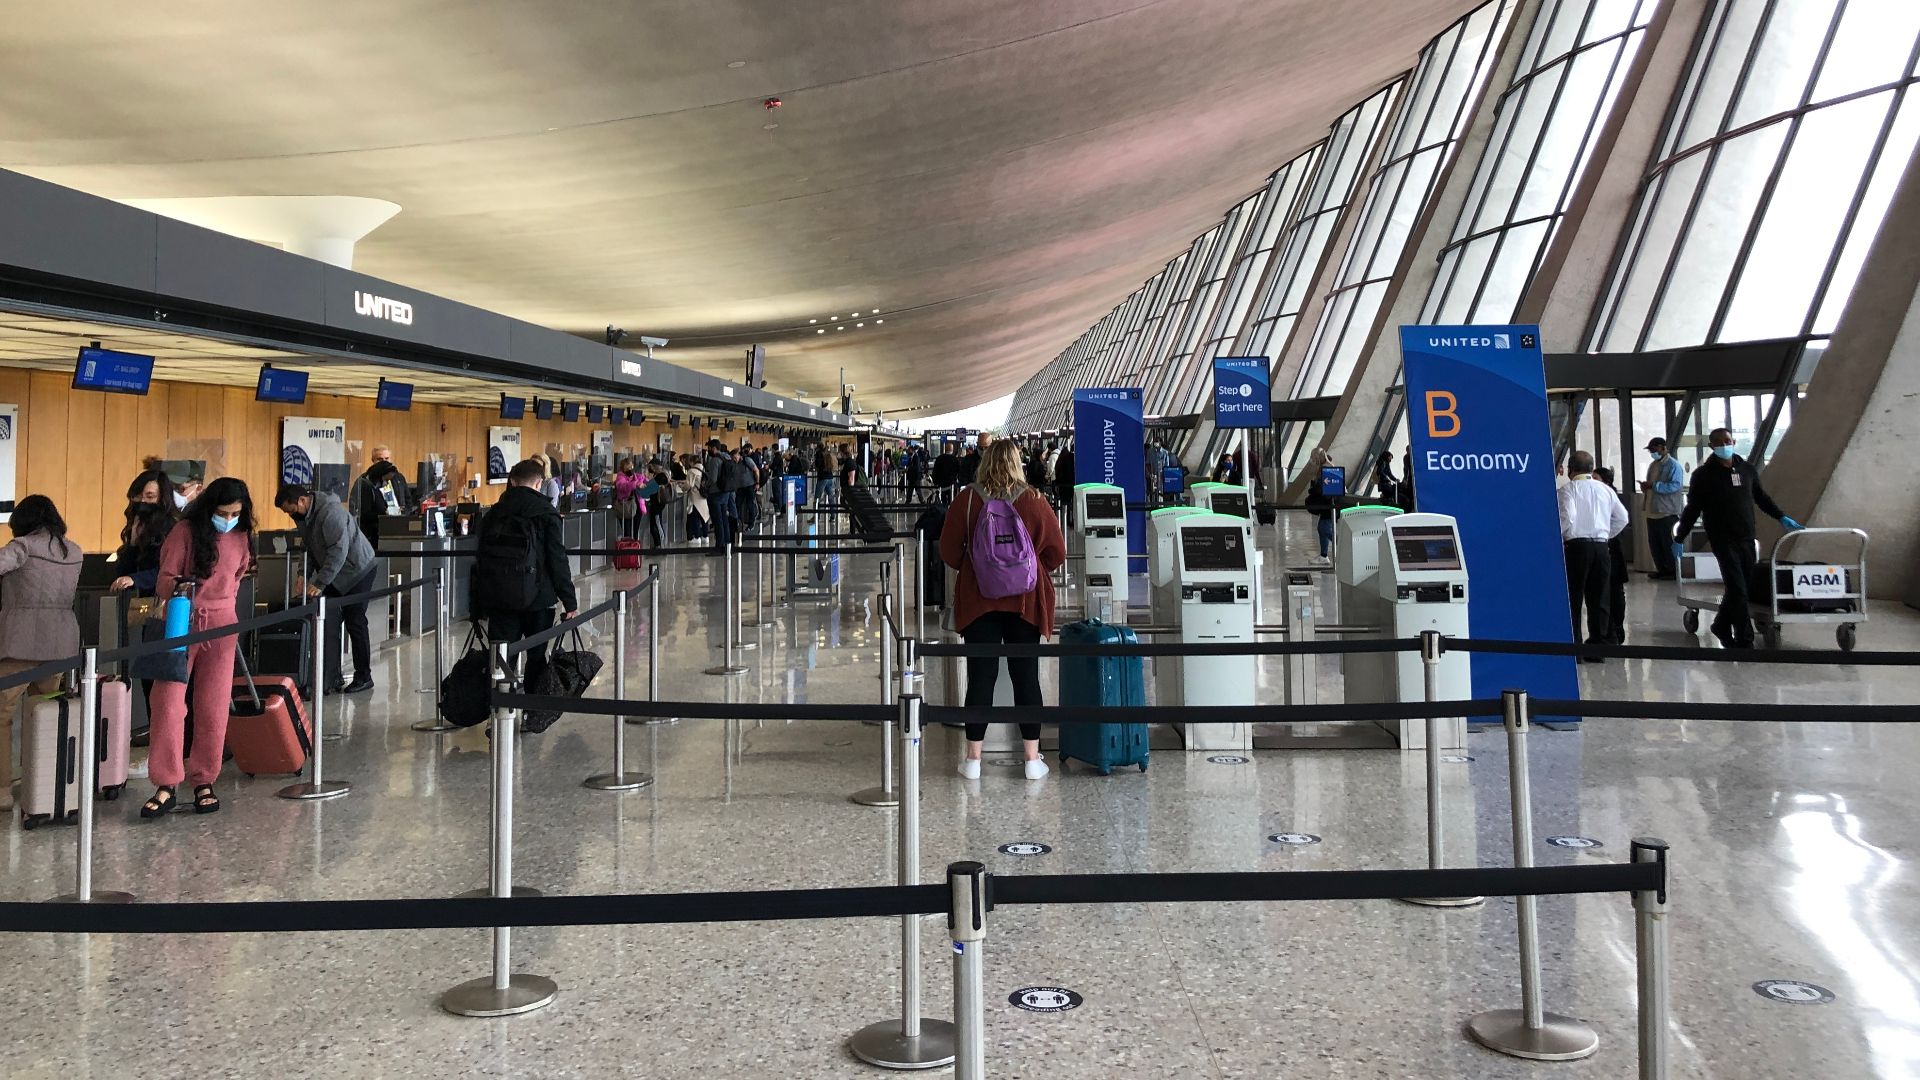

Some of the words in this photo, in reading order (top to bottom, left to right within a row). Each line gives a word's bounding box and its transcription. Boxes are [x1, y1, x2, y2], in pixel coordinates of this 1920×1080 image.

[354, 290, 413, 325] UNITED
[1429, 337, 1491, 347] UNITED
[1218, 385, 1239, 396] Step
[1219, 403, 1241, 412] Start
[1242, 402, 1263, 412] here
[1425, 390, 1461, 438] B
[308, 429, 334, 438] UNITED
[1103, 419, 1116, 485] Additiona
[1426, 451, 1530, 473] Economy
[1797, 574, 1840, 586] ABM
